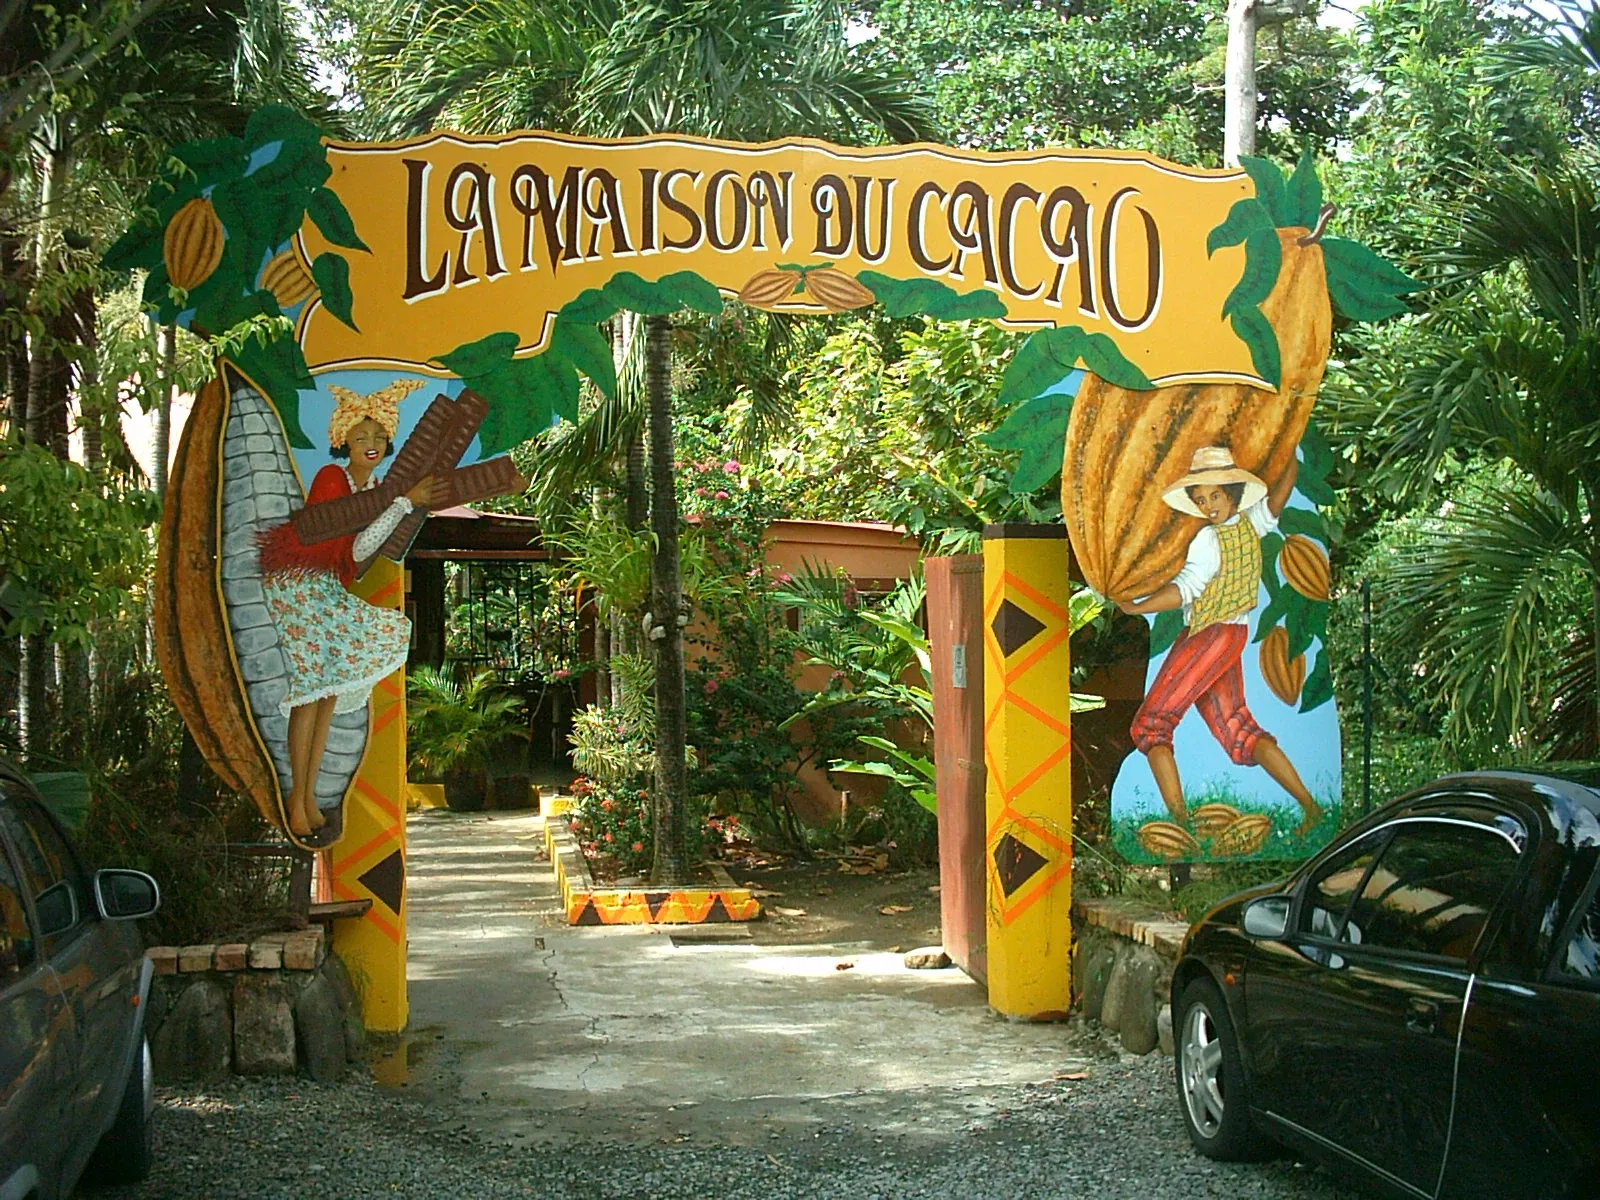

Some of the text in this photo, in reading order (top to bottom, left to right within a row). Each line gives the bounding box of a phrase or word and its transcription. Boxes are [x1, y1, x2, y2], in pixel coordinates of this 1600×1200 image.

[402, 158, 1164, 333] LA MAISON DU CACAO
